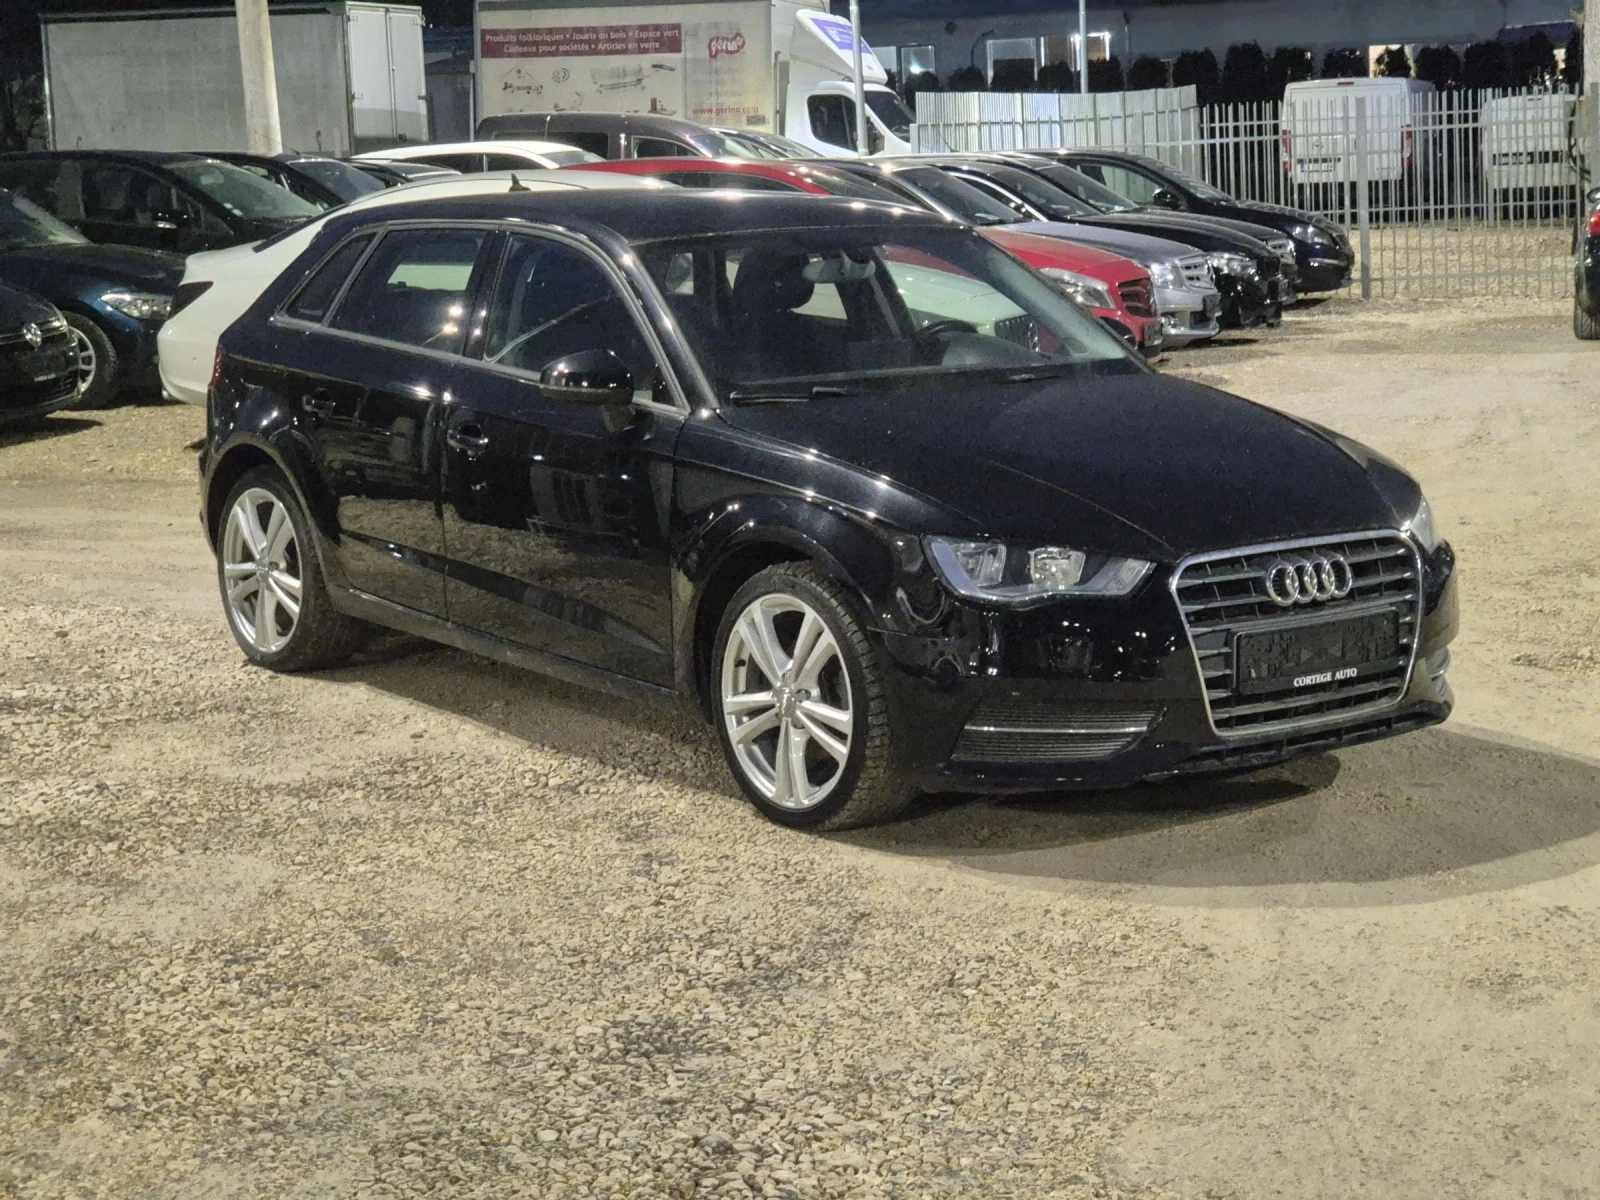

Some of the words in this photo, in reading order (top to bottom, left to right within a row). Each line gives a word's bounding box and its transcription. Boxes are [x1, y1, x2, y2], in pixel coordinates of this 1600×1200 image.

[485, 34, 517, 42] Produits
[519, 33, 564, 43] folkloriques
[572, 32, 597, 40] Jouets
[610, 31, 627, 39] bois
[634, 29, 661, 39] Espace
[663, 29, 679, 37] vert
[504, 44, 537, 53] Cadeaux
[538, 45, 557, 53] pour
[558, 43, 589, 51] sociétés
[597, 42, 626, 50] Articles
[640, 41, 660, 49] verre
[692, 106, 759, 116] www.gerino.com
[1293, 671, 1332, 687] CORTEGE
[1334, 667, 1358, 681] AUTO
